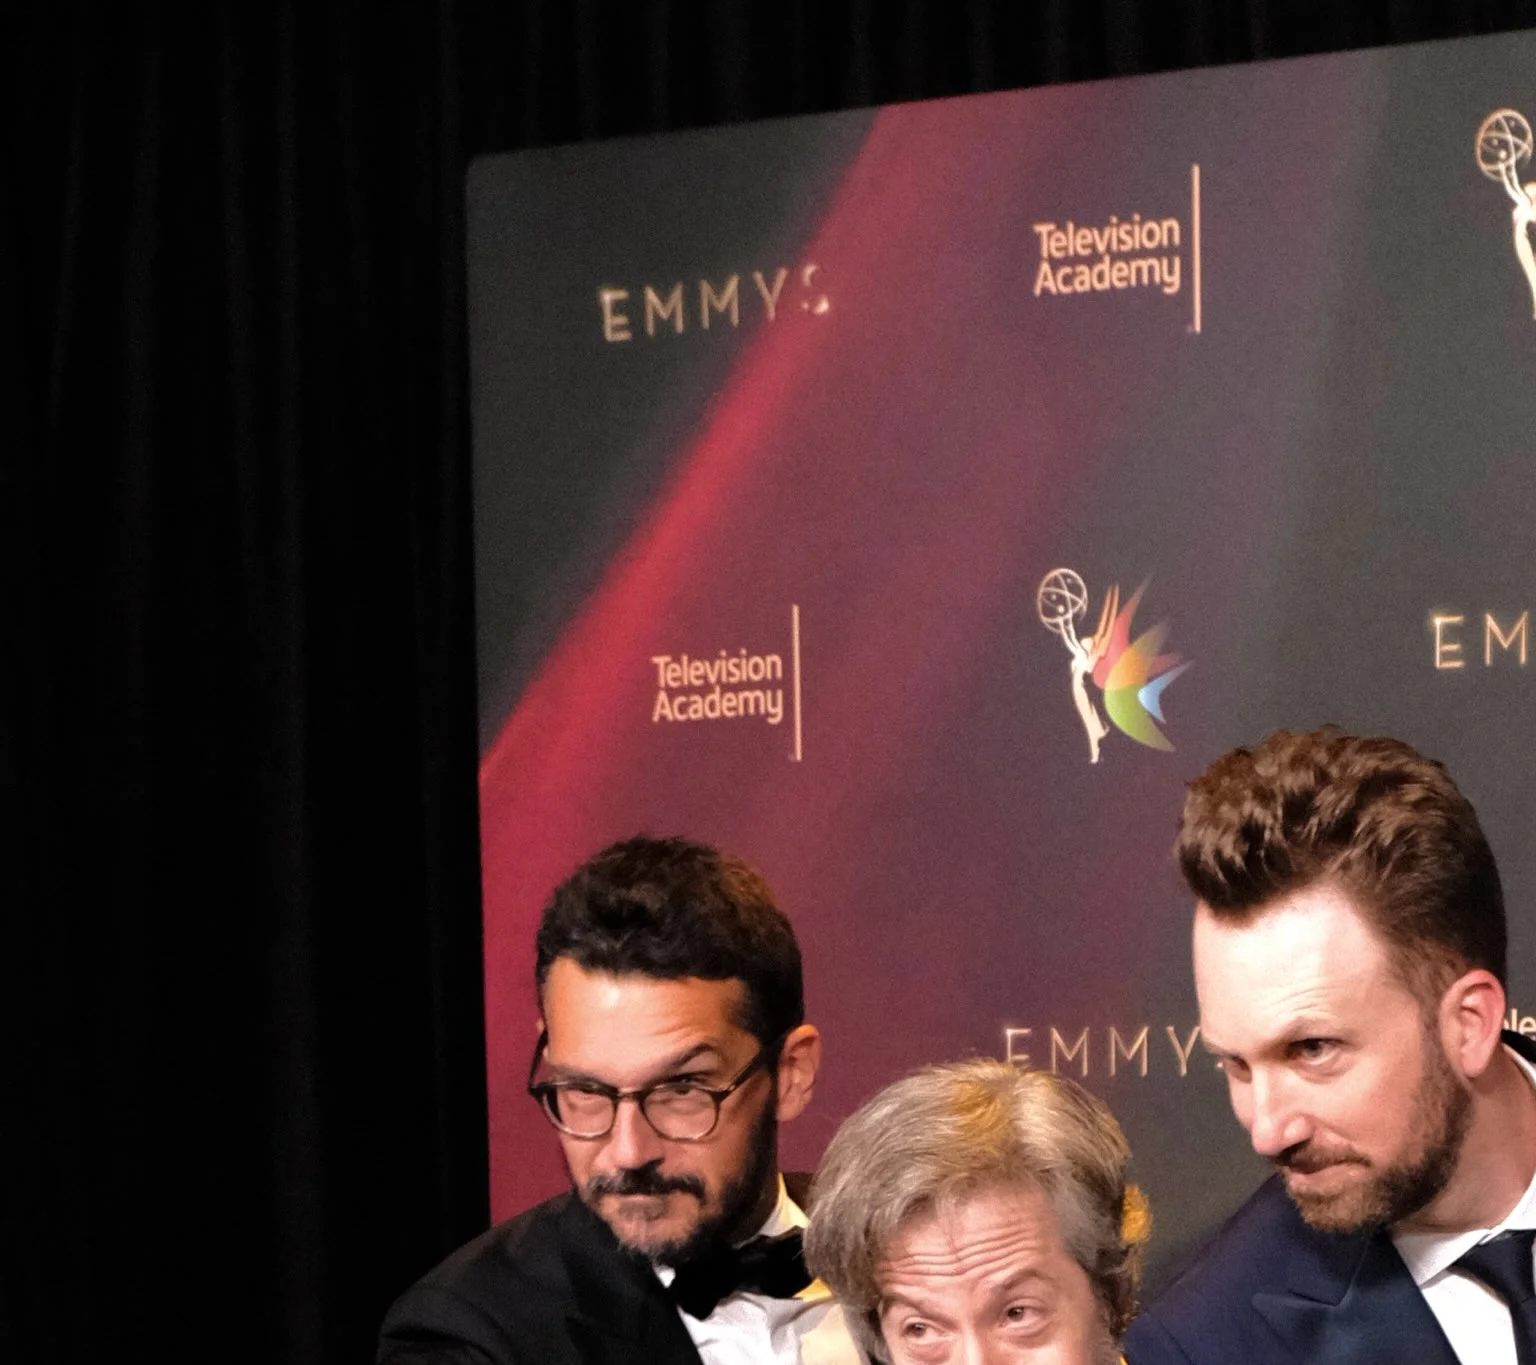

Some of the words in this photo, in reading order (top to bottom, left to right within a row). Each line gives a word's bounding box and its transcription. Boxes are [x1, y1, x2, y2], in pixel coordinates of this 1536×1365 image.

[1032, 212, 1181, 260] Television
[1032, 254, 1182, 297] Academy
[600, 262, 832, 344] EMMYS
[650, 648, 783, 689] Television
[650, 685, 784, 726] Academy
[1004, 1024, 1202, 1078] EMMY
